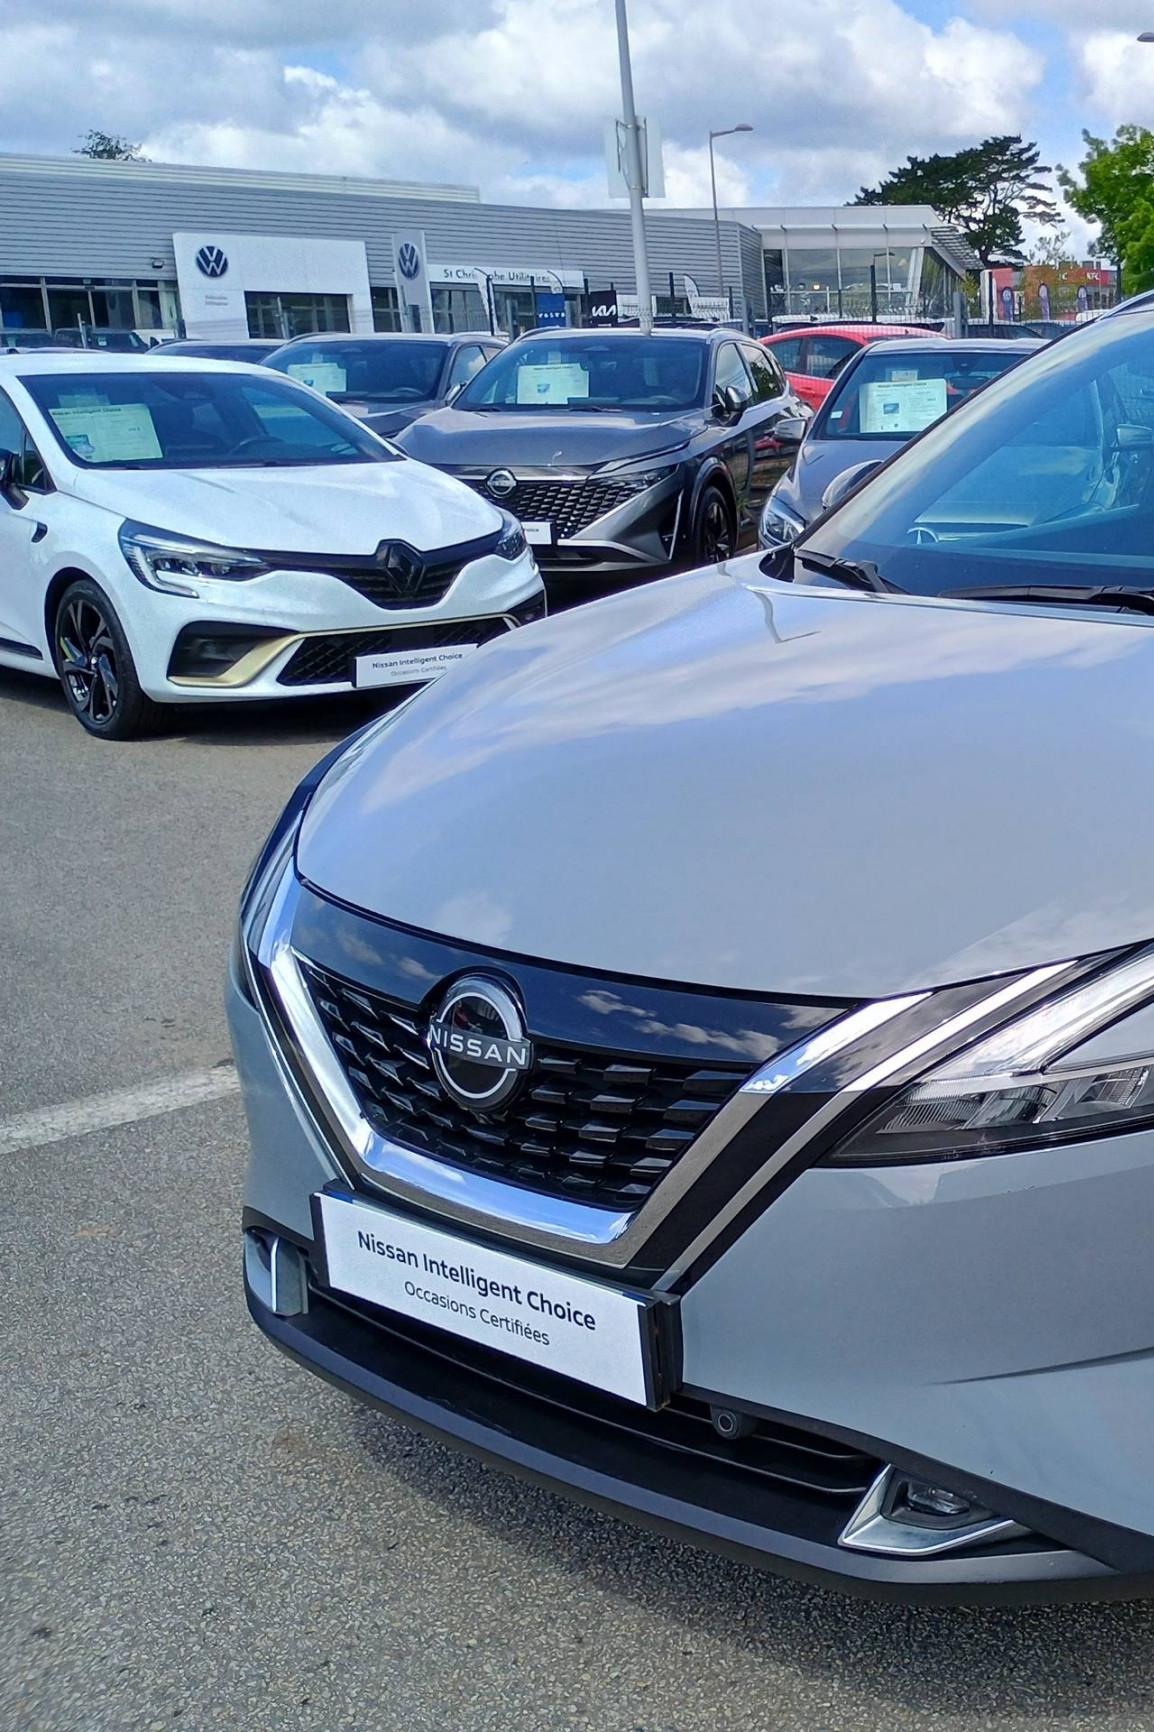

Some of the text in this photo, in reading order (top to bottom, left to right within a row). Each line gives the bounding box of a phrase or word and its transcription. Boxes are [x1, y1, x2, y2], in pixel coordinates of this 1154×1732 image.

[508, 271, 550, 282] Utilitires
[592, 304, 617, 317] KIA
[372, 653, 463, 669] Nissan Intelligent Choice
[428, 1024, 527, 1066] NISSAN
[357, 1230, 597, 1331] Nissan Intelligent Choice
[403, 1280, 550, 1346] Occasions Certifiées
